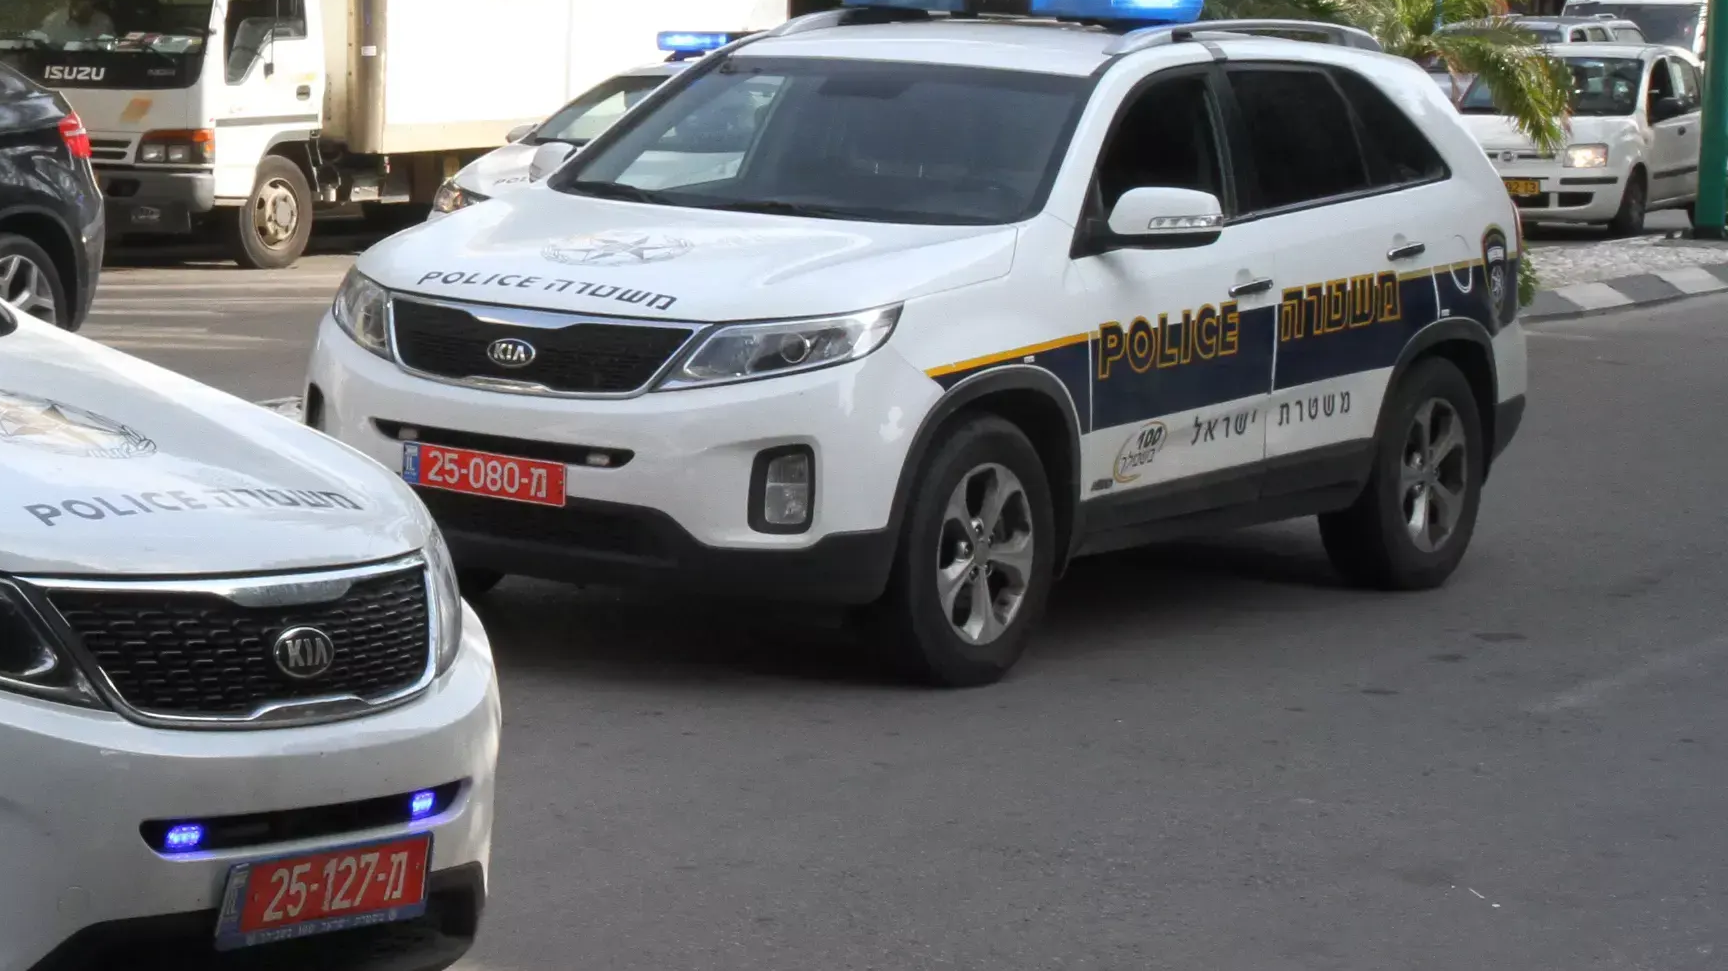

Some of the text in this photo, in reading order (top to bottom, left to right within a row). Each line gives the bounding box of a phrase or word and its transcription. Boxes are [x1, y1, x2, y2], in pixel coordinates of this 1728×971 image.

[44, 65, 106, 81] ISUZU
[417, 271, 541, 288] POLICE
[544, 279, 678, 310] משטרה
[1280, 271, 1402, 342] משטרה
[493, 342, 528, 362] KIA
[1097, 301, 1240, 380] POLICE
[1190, 391, 1352, 445] משטרת ישראל
[23, 490, 208, 527] POLICE
[204, 488, 364, 511] משטרה
[285, 635, 329, 672] KIA
